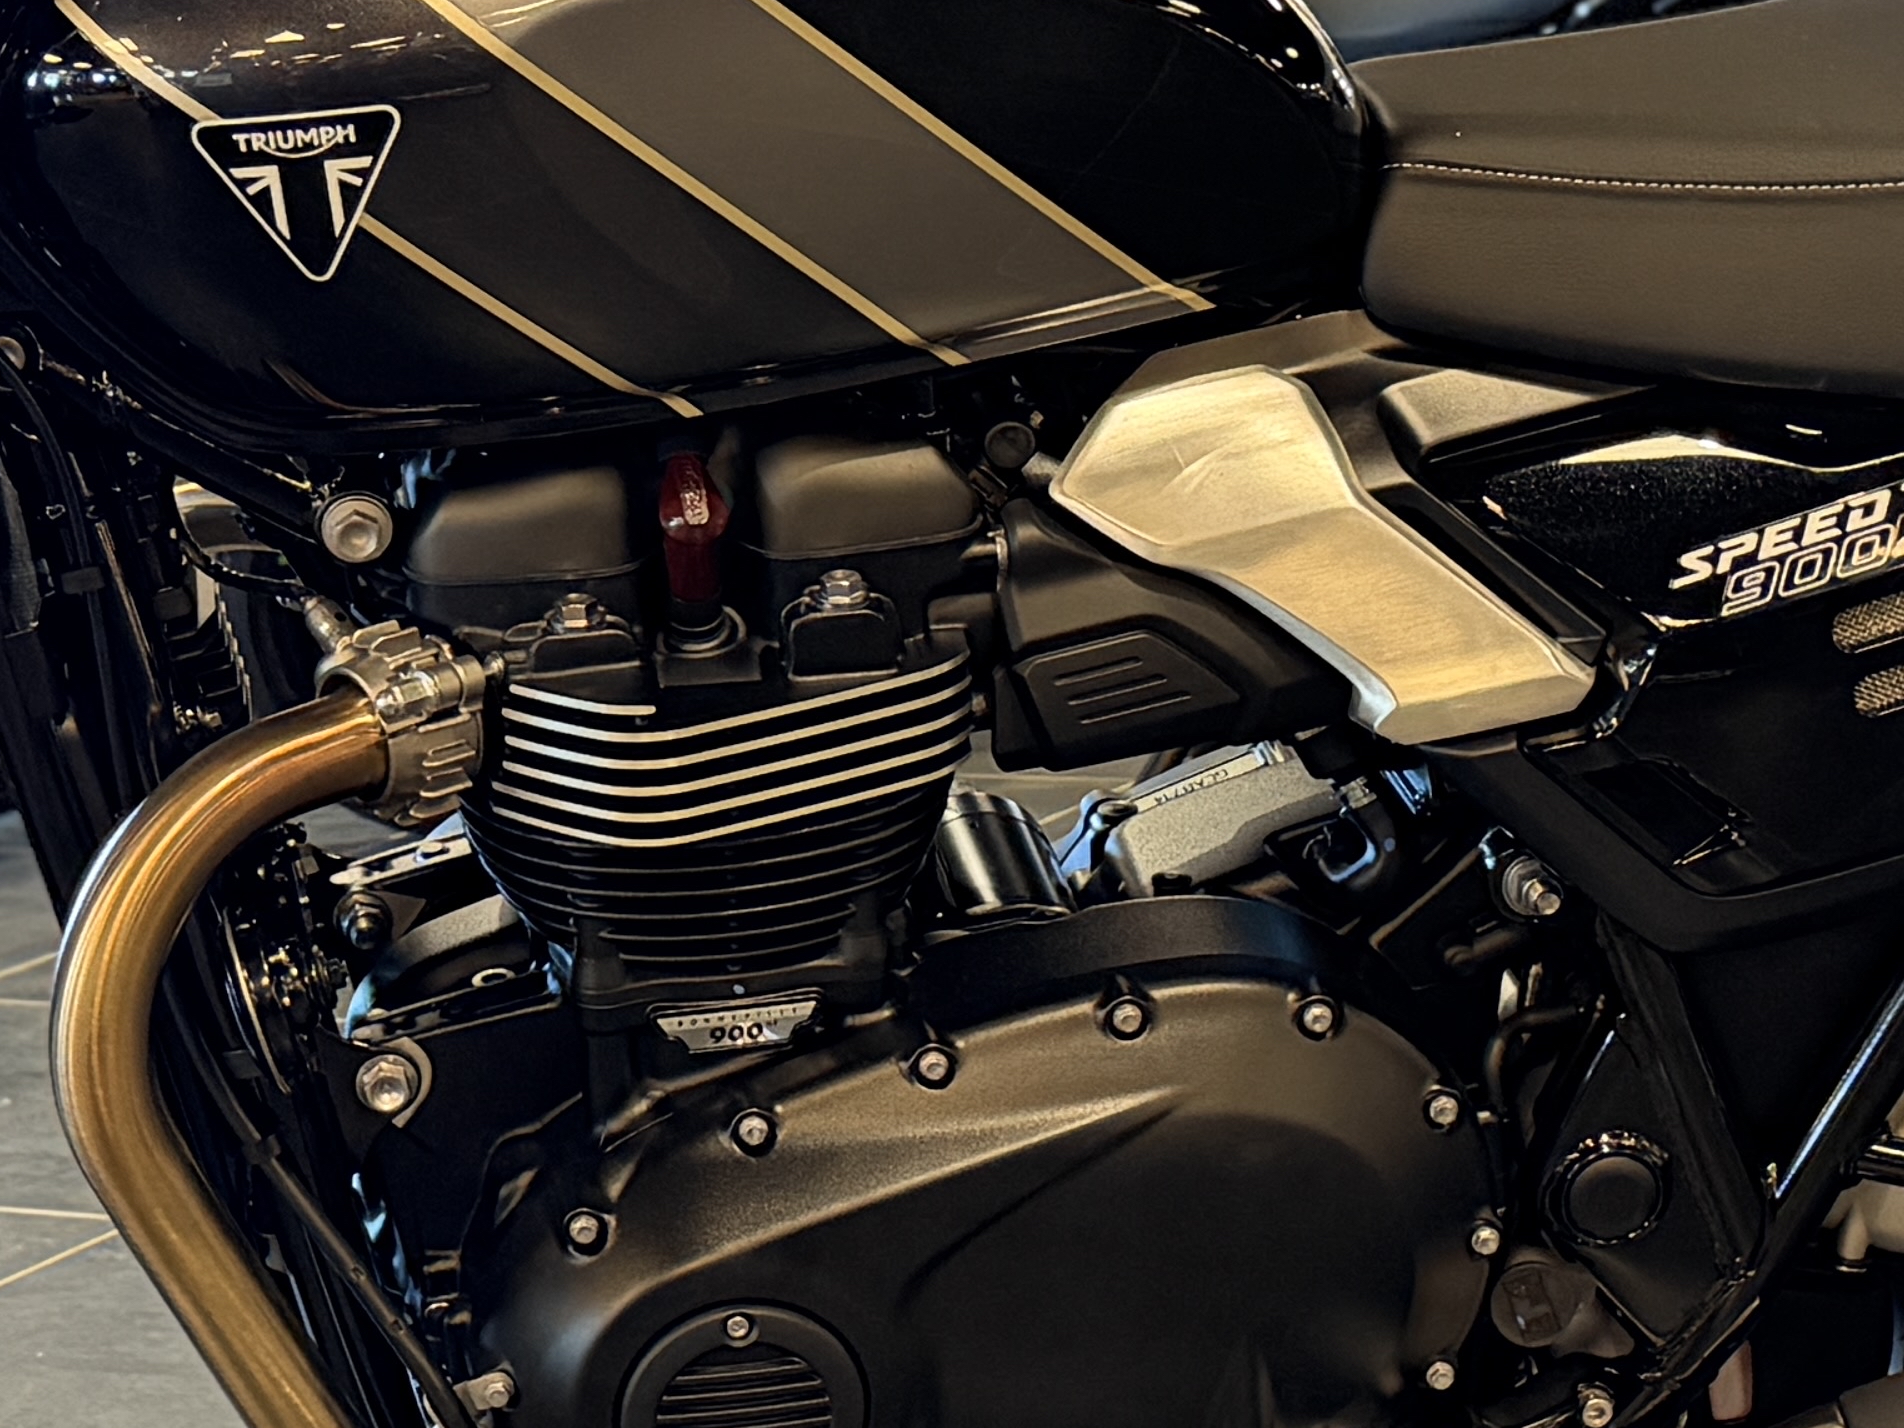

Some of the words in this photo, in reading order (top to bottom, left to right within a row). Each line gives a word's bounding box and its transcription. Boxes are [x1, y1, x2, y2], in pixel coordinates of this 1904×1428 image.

[231, 123, 358, 159] TRIUMPH
[1668, 489, 1892, 590] SPEED
[1720, 524, 1900, 617] 900
[709, 1022, 764, 1044] 900
